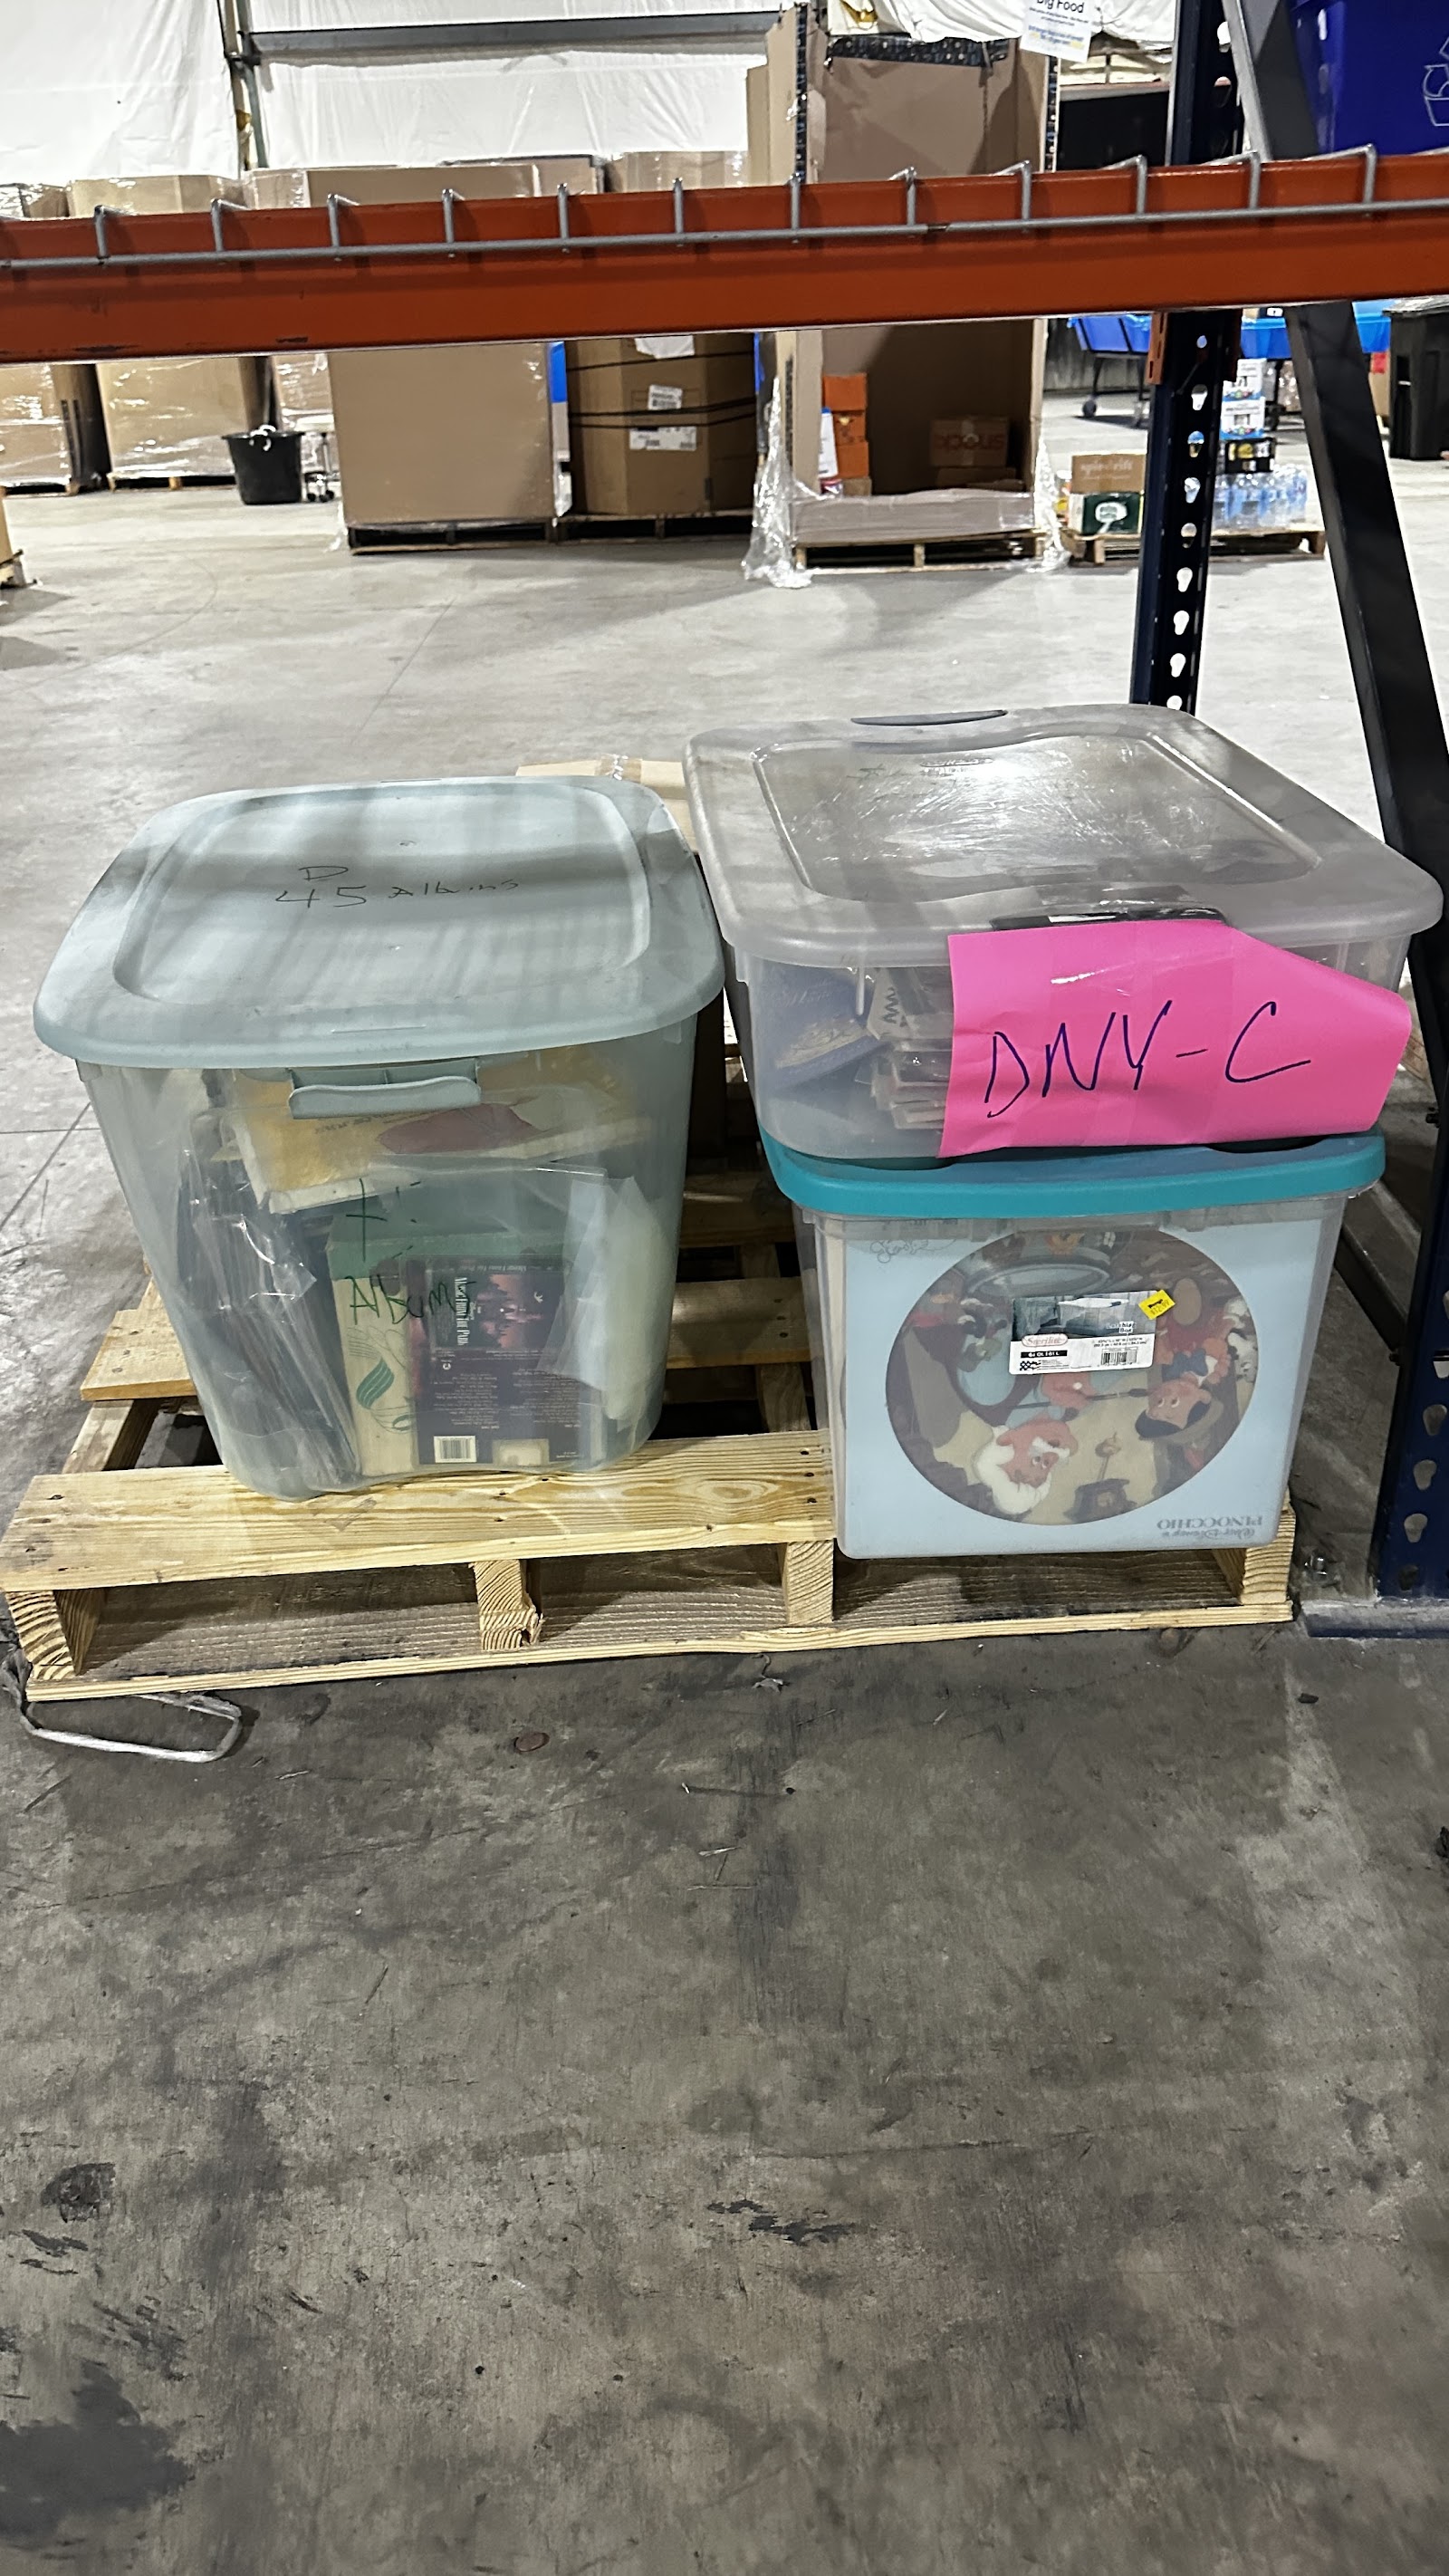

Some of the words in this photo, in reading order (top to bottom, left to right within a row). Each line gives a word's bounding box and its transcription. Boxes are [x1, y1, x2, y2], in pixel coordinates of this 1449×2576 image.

[1057, 0, 1085, 14] Food
[274, 885, 367, 908] 45
[1156, 1514, 1263, 1530] PINOCCHIO
